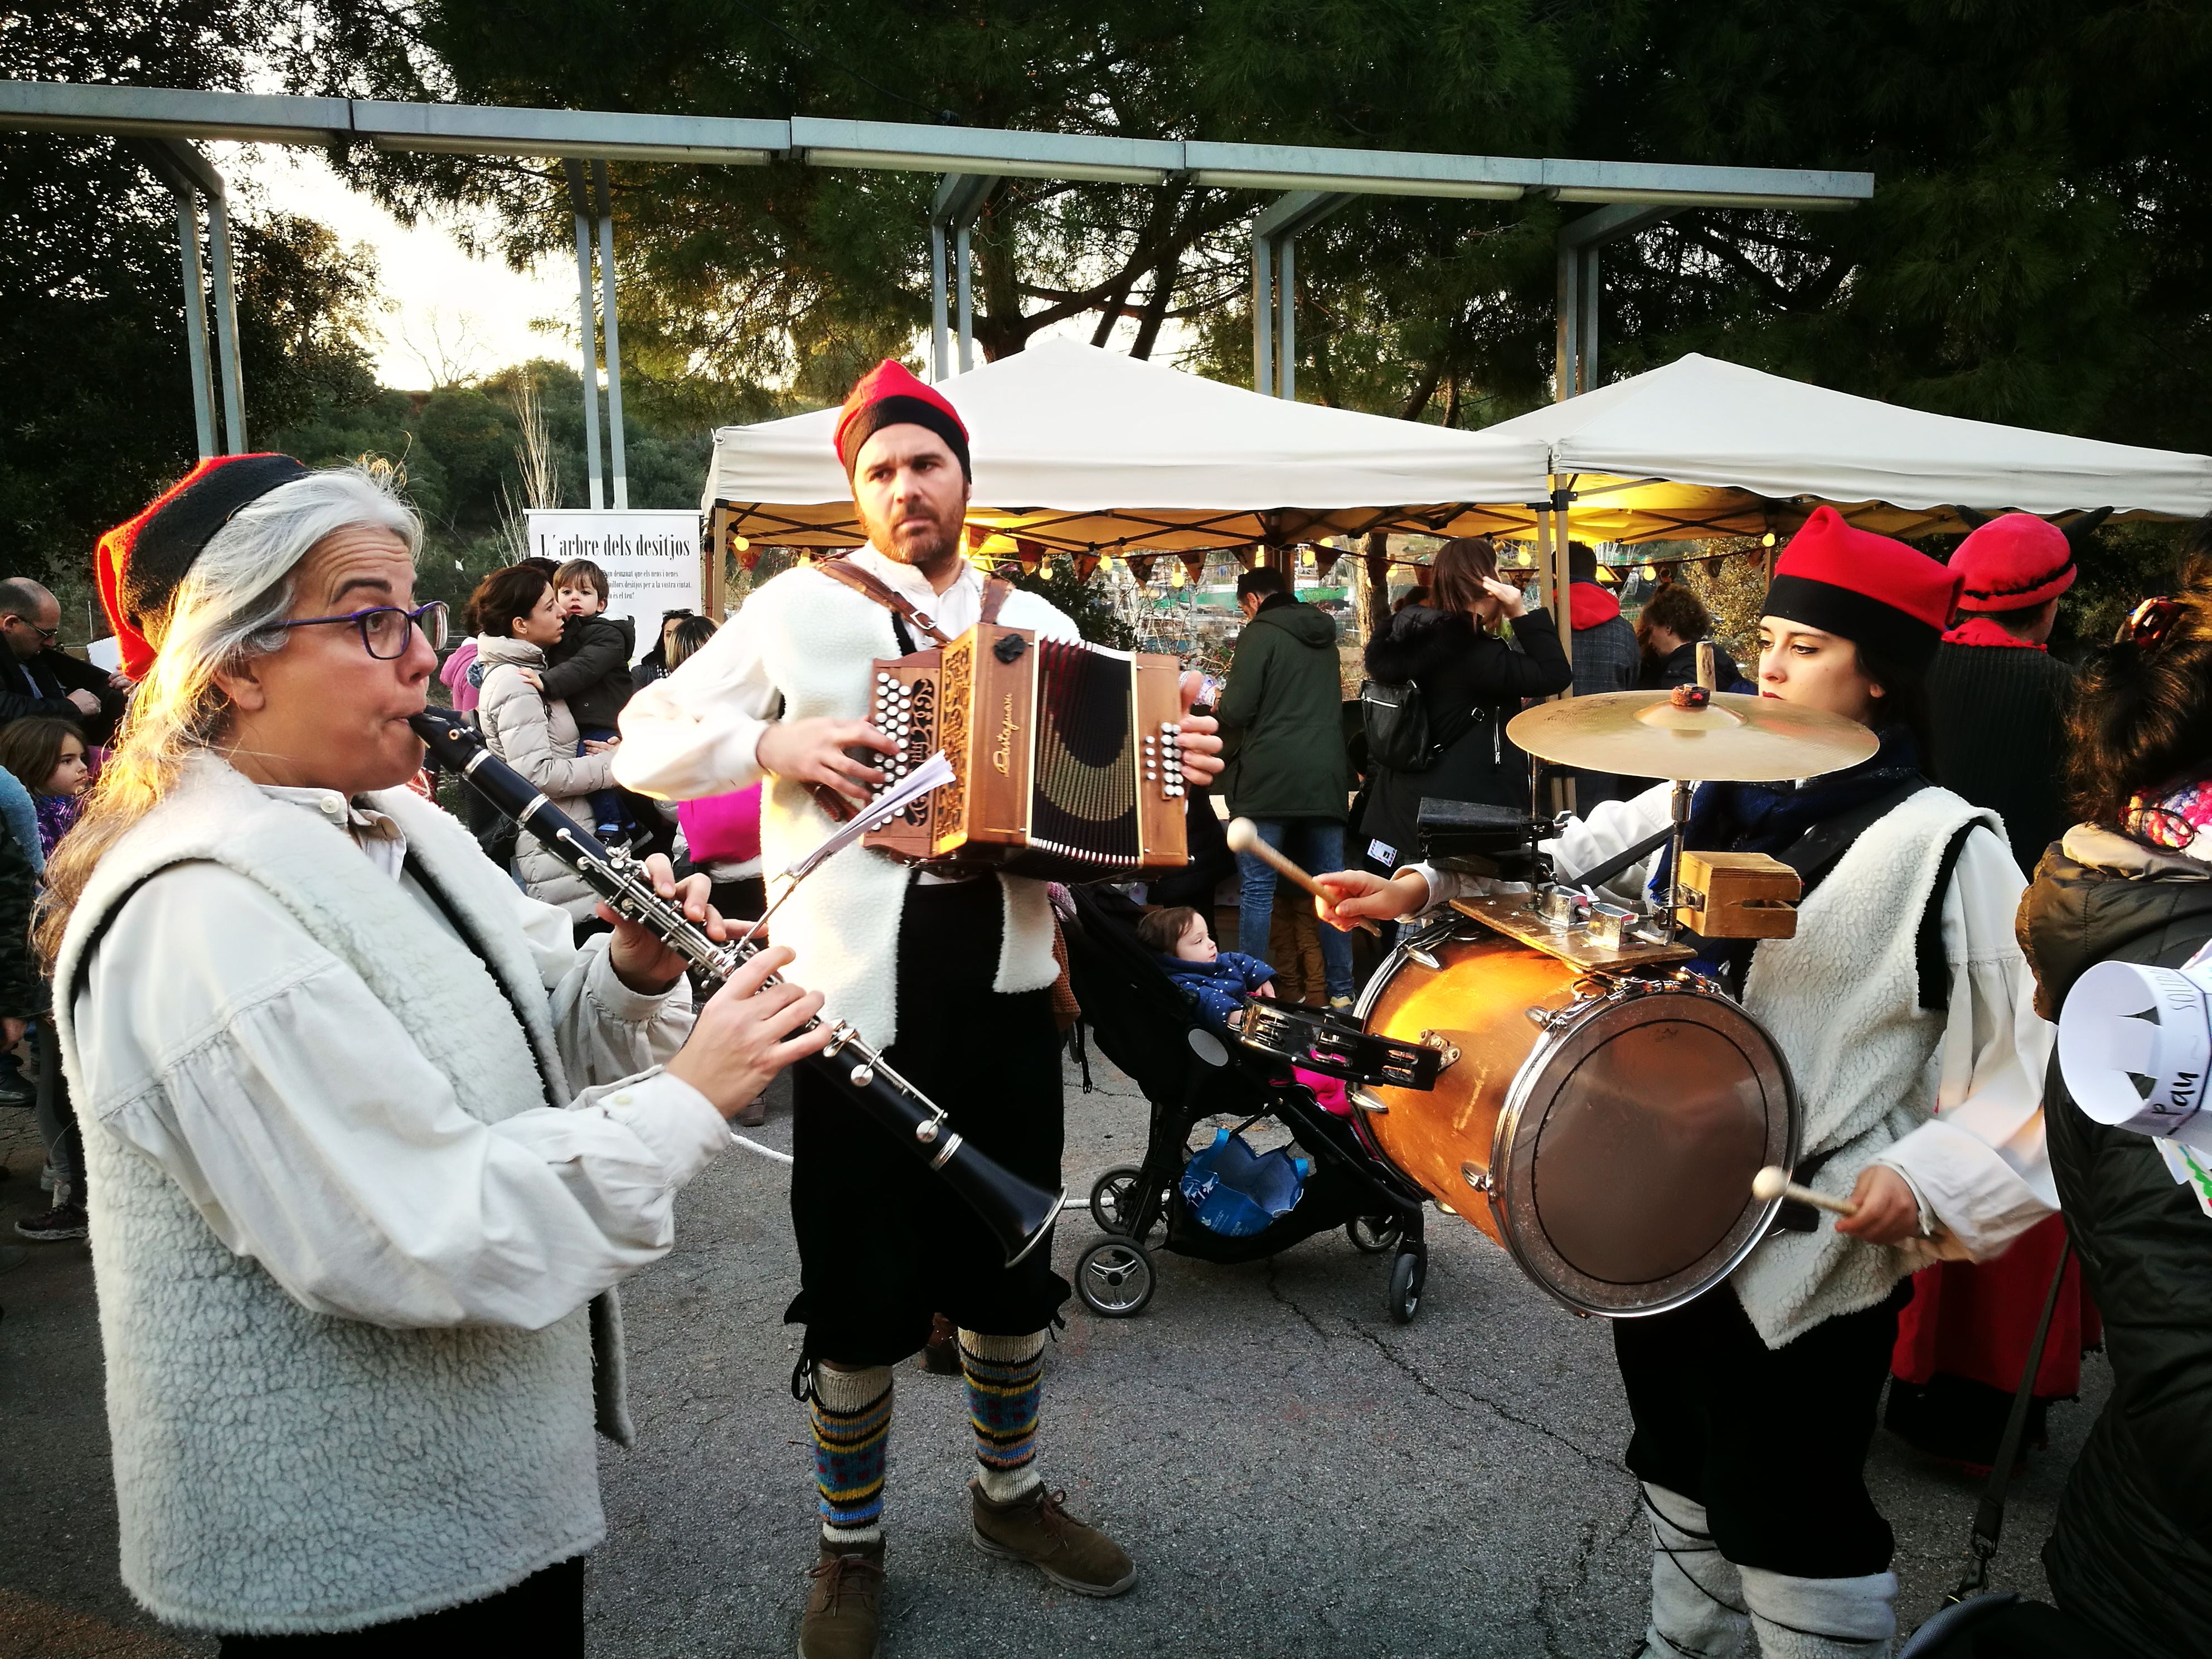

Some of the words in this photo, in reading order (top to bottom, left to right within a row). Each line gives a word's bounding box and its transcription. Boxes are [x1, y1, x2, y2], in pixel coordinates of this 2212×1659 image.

[604, 533, 631, 556] dels
[636, 533, 690, 561] desitjos
[624, 580, 642, 590] desitjos
[2152, 1071, 2199, 1115] Pau
